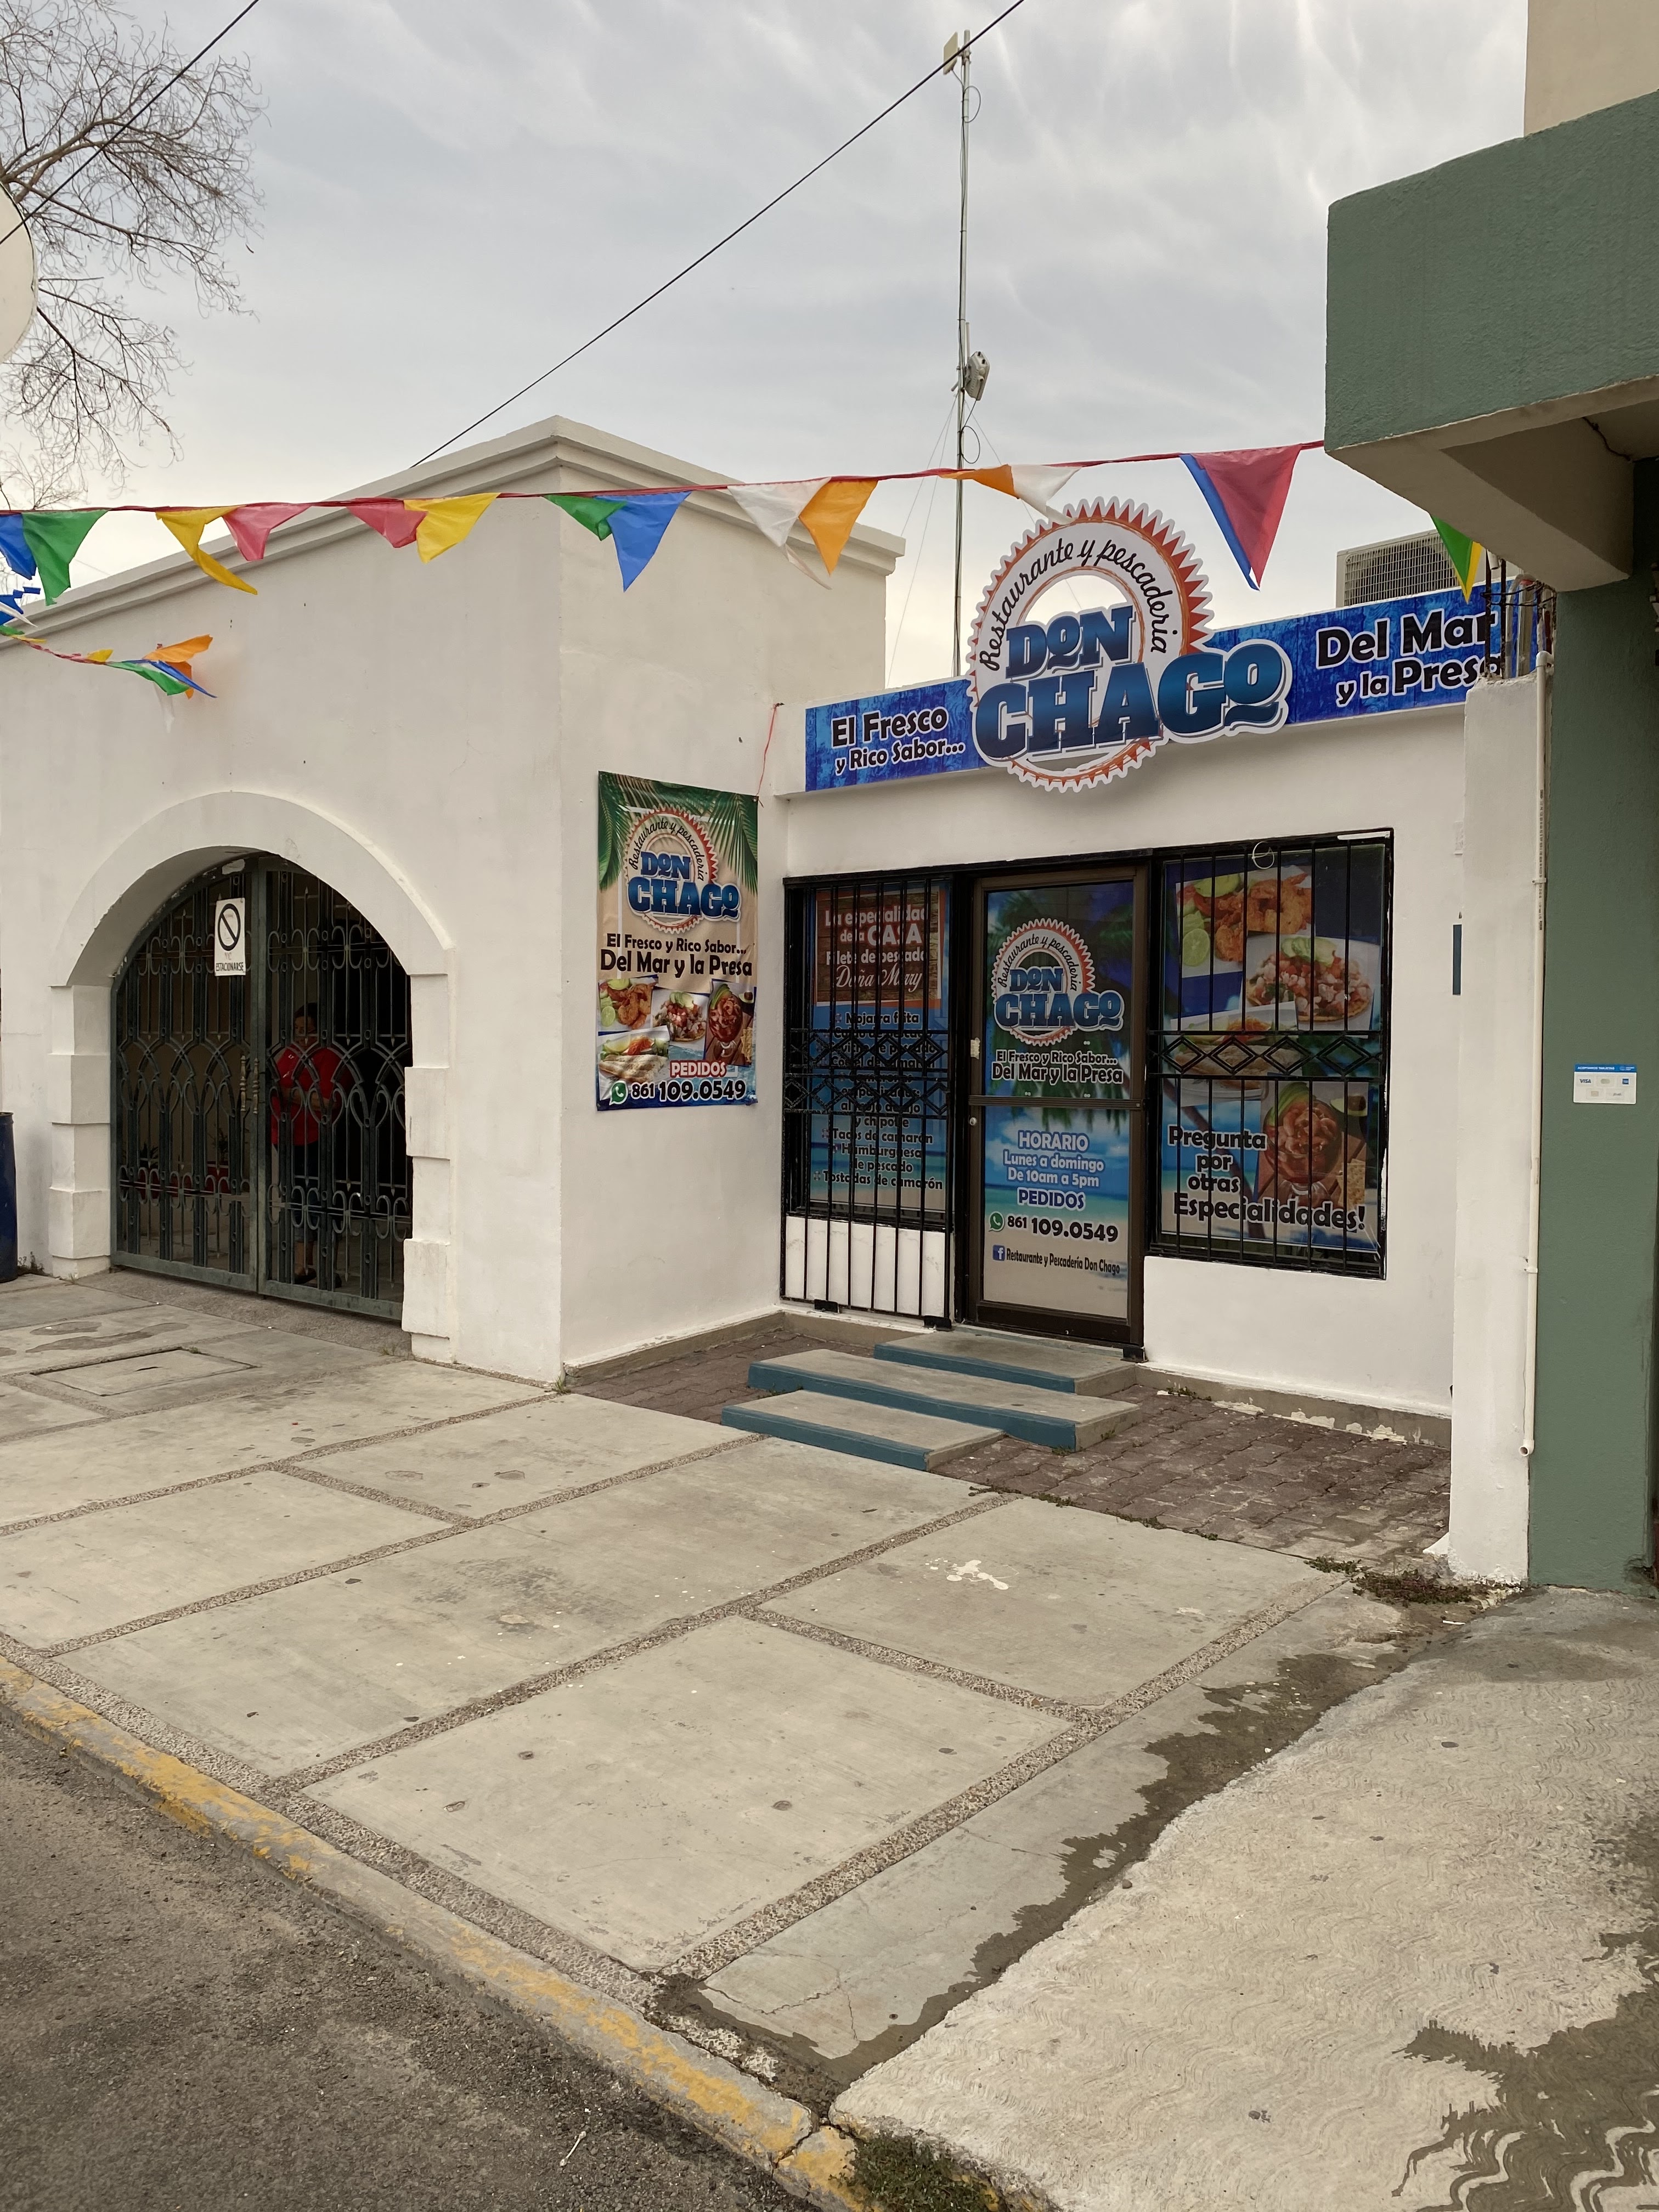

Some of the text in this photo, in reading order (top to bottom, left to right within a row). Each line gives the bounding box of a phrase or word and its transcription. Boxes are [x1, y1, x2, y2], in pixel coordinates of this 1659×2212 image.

[980, 537, 1074, 670] Restaurante
[1078, 540, 1095, 565] y
[1006, 606, 1135, 679] DON
[1318, 611, 1496, 667] Del Mar
[1338, 682, 1355, 705] y
[1362, 674, 1386, 696] la
[976, 644, 1285, 760] CHAGO
[832, 707, 948, 747] El Fresco
[836, 737, 964, 775] y Rico Sabor...
[629, 818, 668, 870] Restaurante
[669, 823, 677, 834] y
[641, 851, 691, 880] DON
[628, 876, 740, 918] CHAGO
[607, 933, 746, 955] El Fresco y Rico Sabor...
[840, 929, 853, 942] de
[216, 962, 244, 971] ESTACIONARSE
[601, 949, 752, 978] Del Mar y la Presa
[861, 949, 876, 963] de
[997, 933, 1040, 988] Restaurante
[1040, 936, 1048, 947] y
[1009, 968, 1063, 992] DON
[894, 1012, 919, 1023] fita
[996, 992, 1121, 1028] CHAGO
[997, 1051, 1116, 1064] El Fresco y Rico Sabor...
[672, 1062, 726, 1077] PEDIDOS
[992, 1063, 1122, 1084] Del Mar y la Presa
[632, 1081, 746, 1101] 861 109.0549
[864, 1116, 909, 1128] chpote
[832, 1128, 861, 1140] Tacs
[1019, 1132, 1088, 1151] HORARIO
[1169, 1126, 1266, 1150] Pregunta
[842, 1143, 923, 1158] Hmburgesa
[1004, 1152, 1104, 1172] Lunes a domingo
[1197, 1155, 1232, 1172] por
[1008, 1169, 1099, 1188] De 10am a 5pm
[1188, 1176, 1240, 1193] otras
[1019, 1189, 1084, 1209] PEDIDOS
[1173, 1193, 1365, 1232] Especialidades!
[1007, 1216, 1119, 1242] 861 109.0549
[1007, 1248, 1042, 1265] Restaurante
[1044, 1256, 1048, 1267] y
[1049, 1253, 1083, 1268] Pescadería
[1085, 1257, 1097, 1271] Don
[1099, 1260, 1120, 1276] Chago
